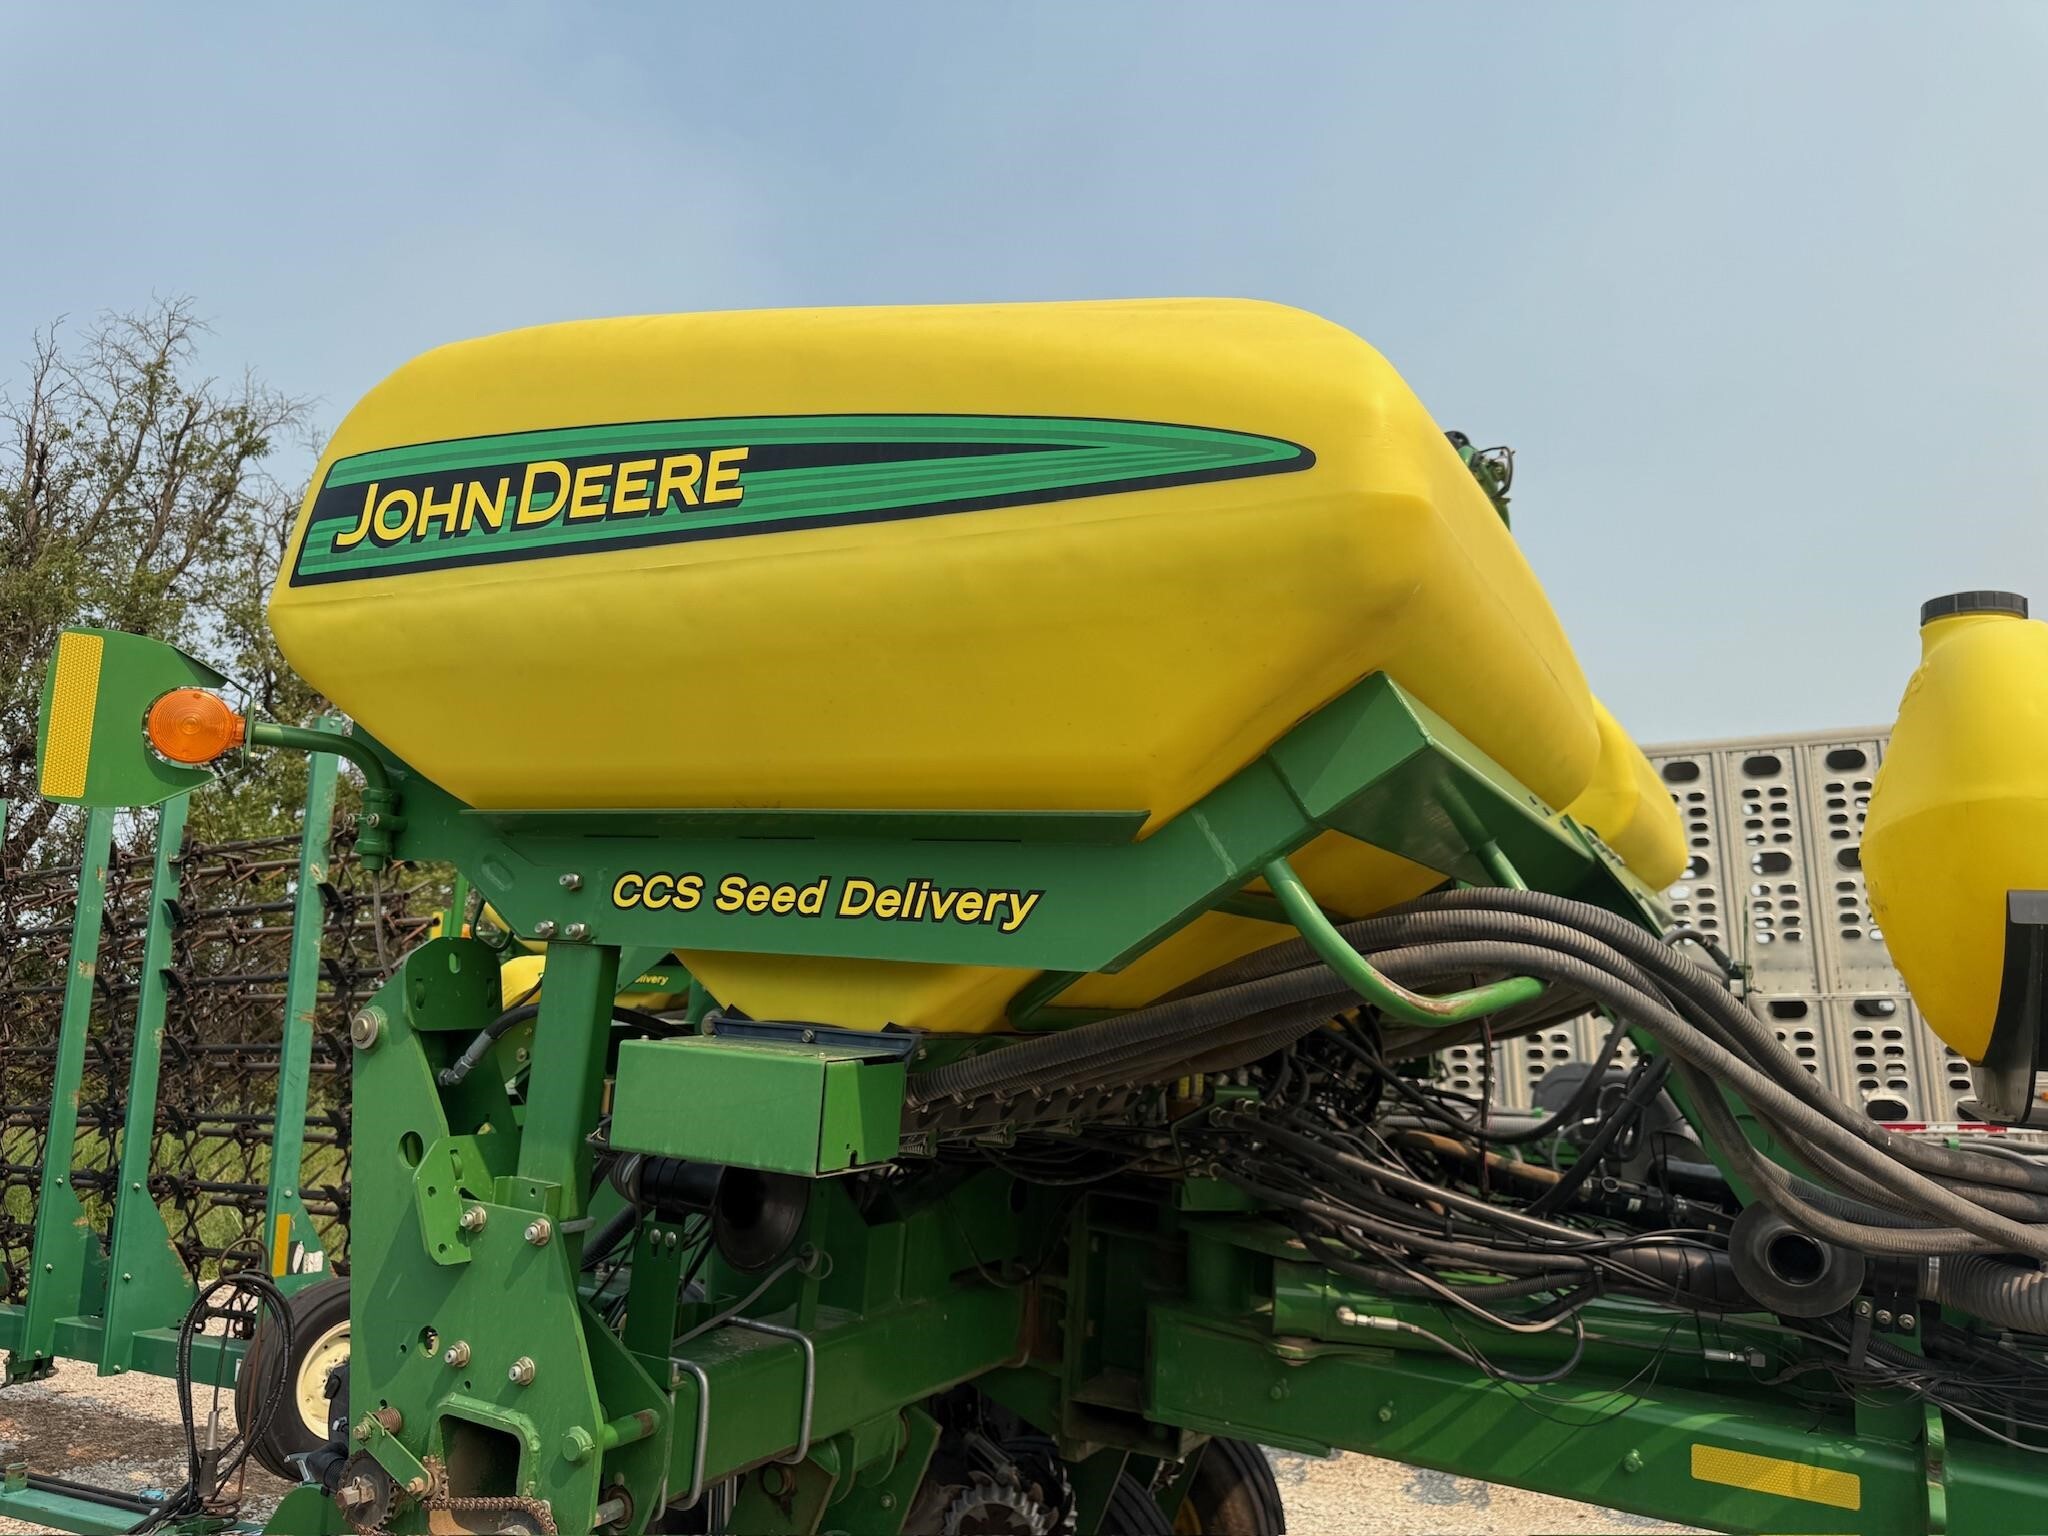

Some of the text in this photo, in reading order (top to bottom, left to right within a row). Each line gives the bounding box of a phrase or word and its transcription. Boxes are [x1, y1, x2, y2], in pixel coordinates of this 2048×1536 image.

[334, 446, 750, 549] JOHN DEERE
[612, 873, 1040, 932] CCS Seed Delivery
